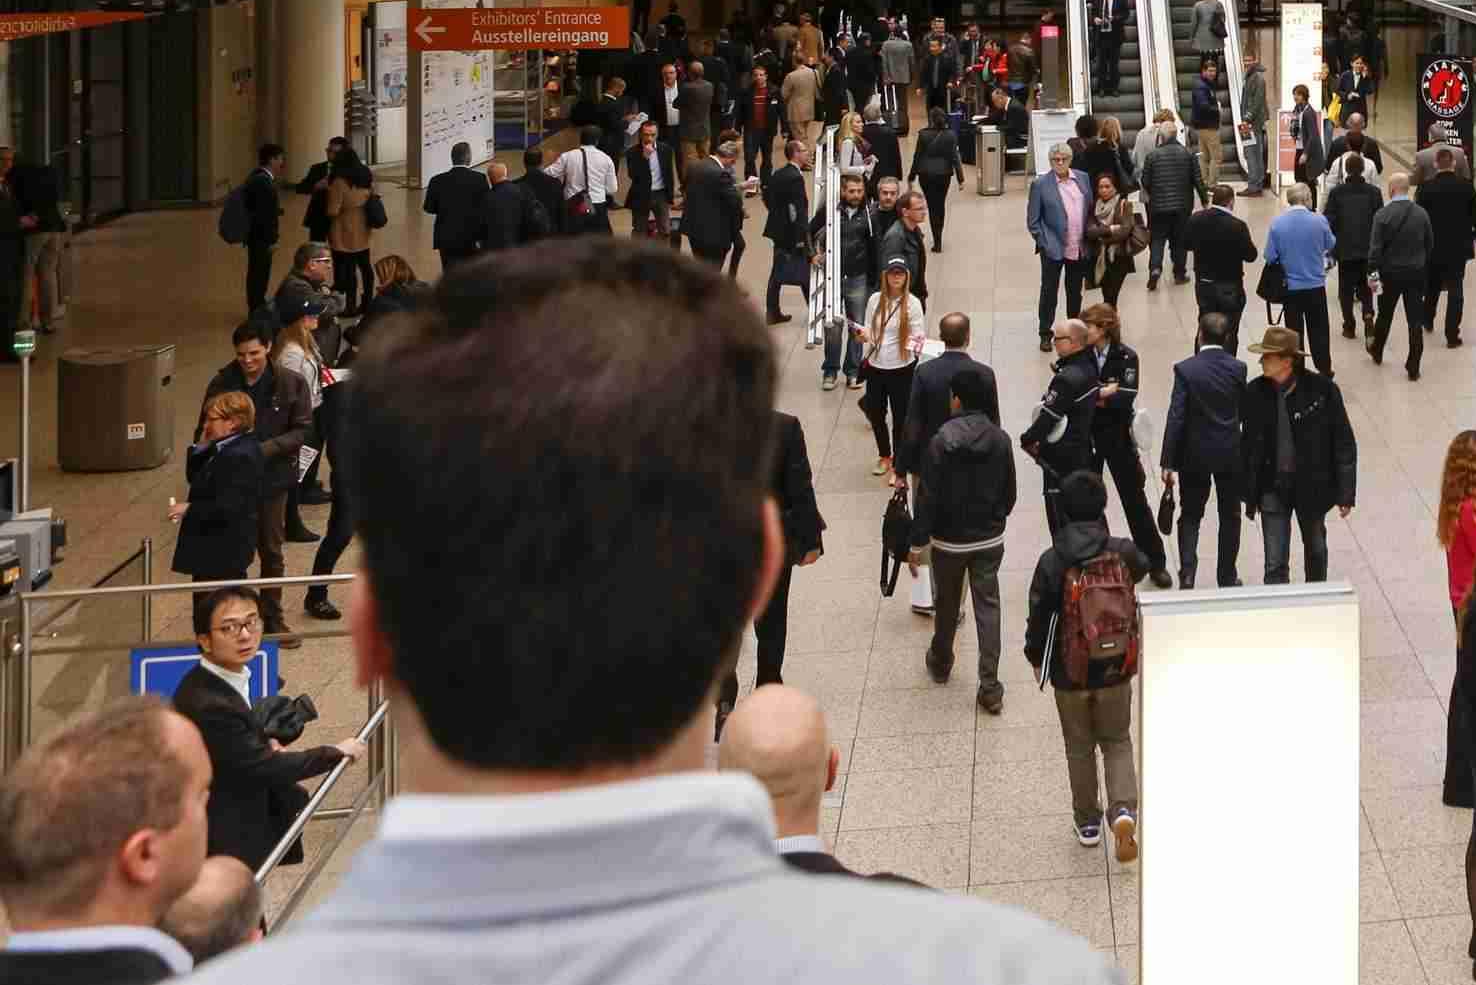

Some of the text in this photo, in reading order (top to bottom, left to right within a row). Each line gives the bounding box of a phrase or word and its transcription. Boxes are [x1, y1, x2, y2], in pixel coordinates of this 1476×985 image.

[471, 10, 602, 25] Exhibitors' Entrance
[471, 29, 609, 46] Ausstellereingang
